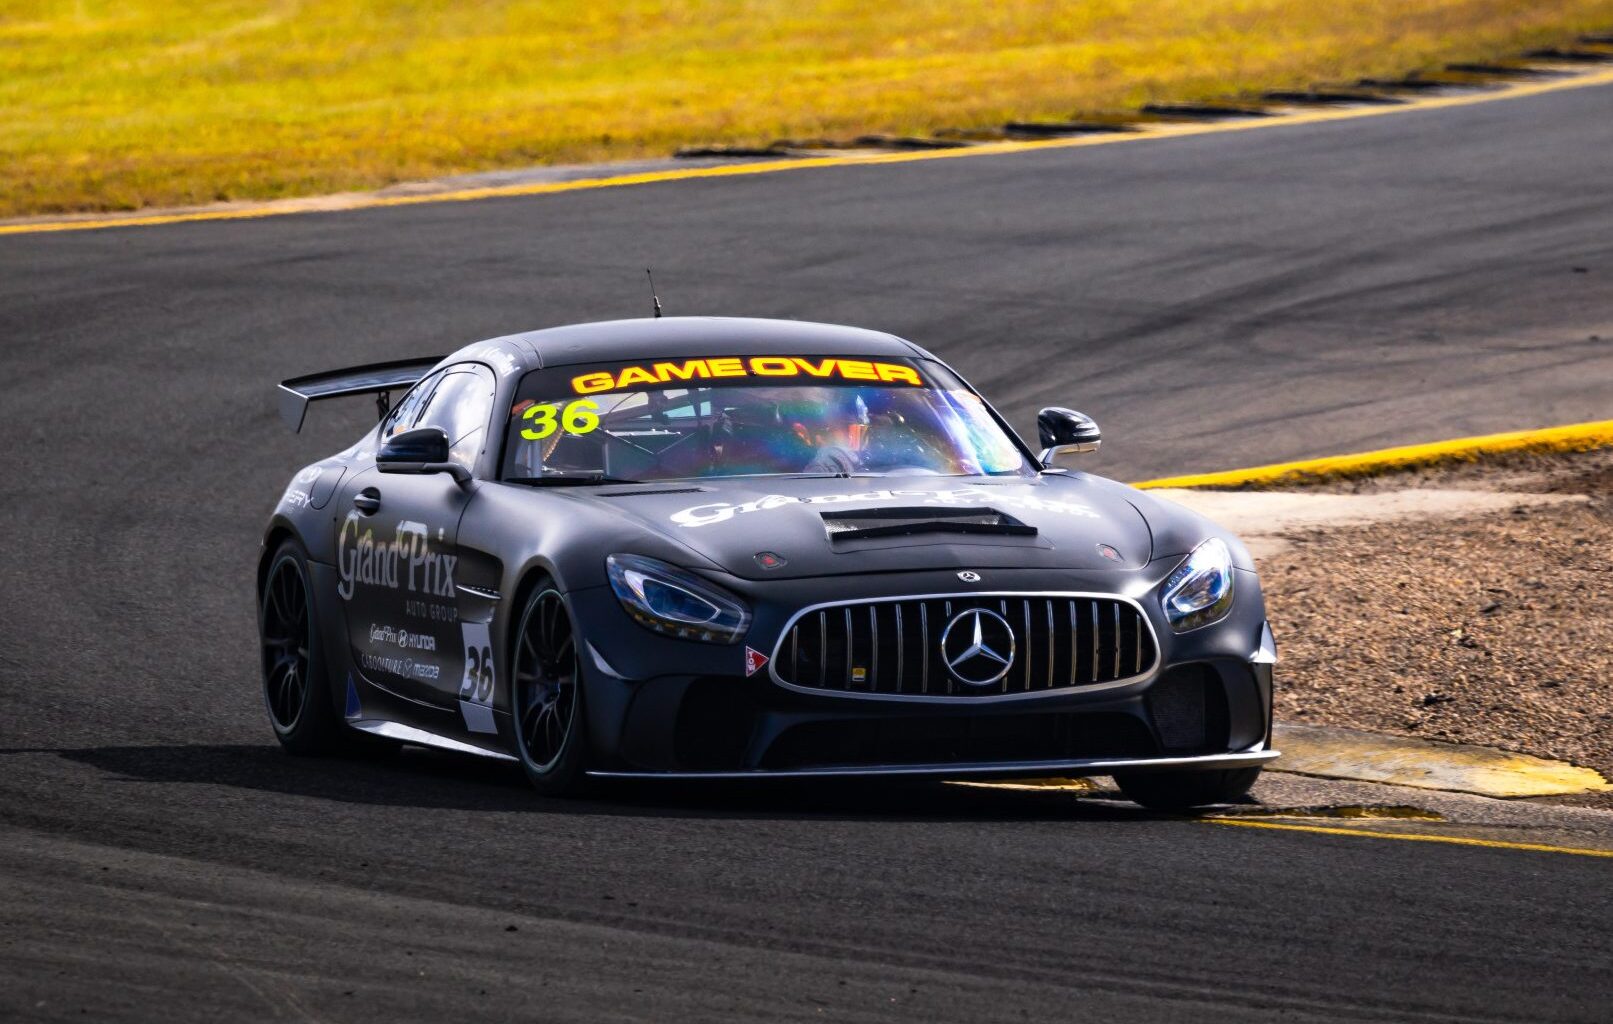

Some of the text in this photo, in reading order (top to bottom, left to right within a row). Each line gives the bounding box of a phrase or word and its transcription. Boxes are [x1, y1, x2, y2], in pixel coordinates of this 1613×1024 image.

[520, 401, 601, 440] 36
[338, 509, 458, 601] Grand Prix
[406, 600, 458, 622] AUTO GROUP
[461, 645, 493, 702] 36
[747, 650, 756, 672] TOW
